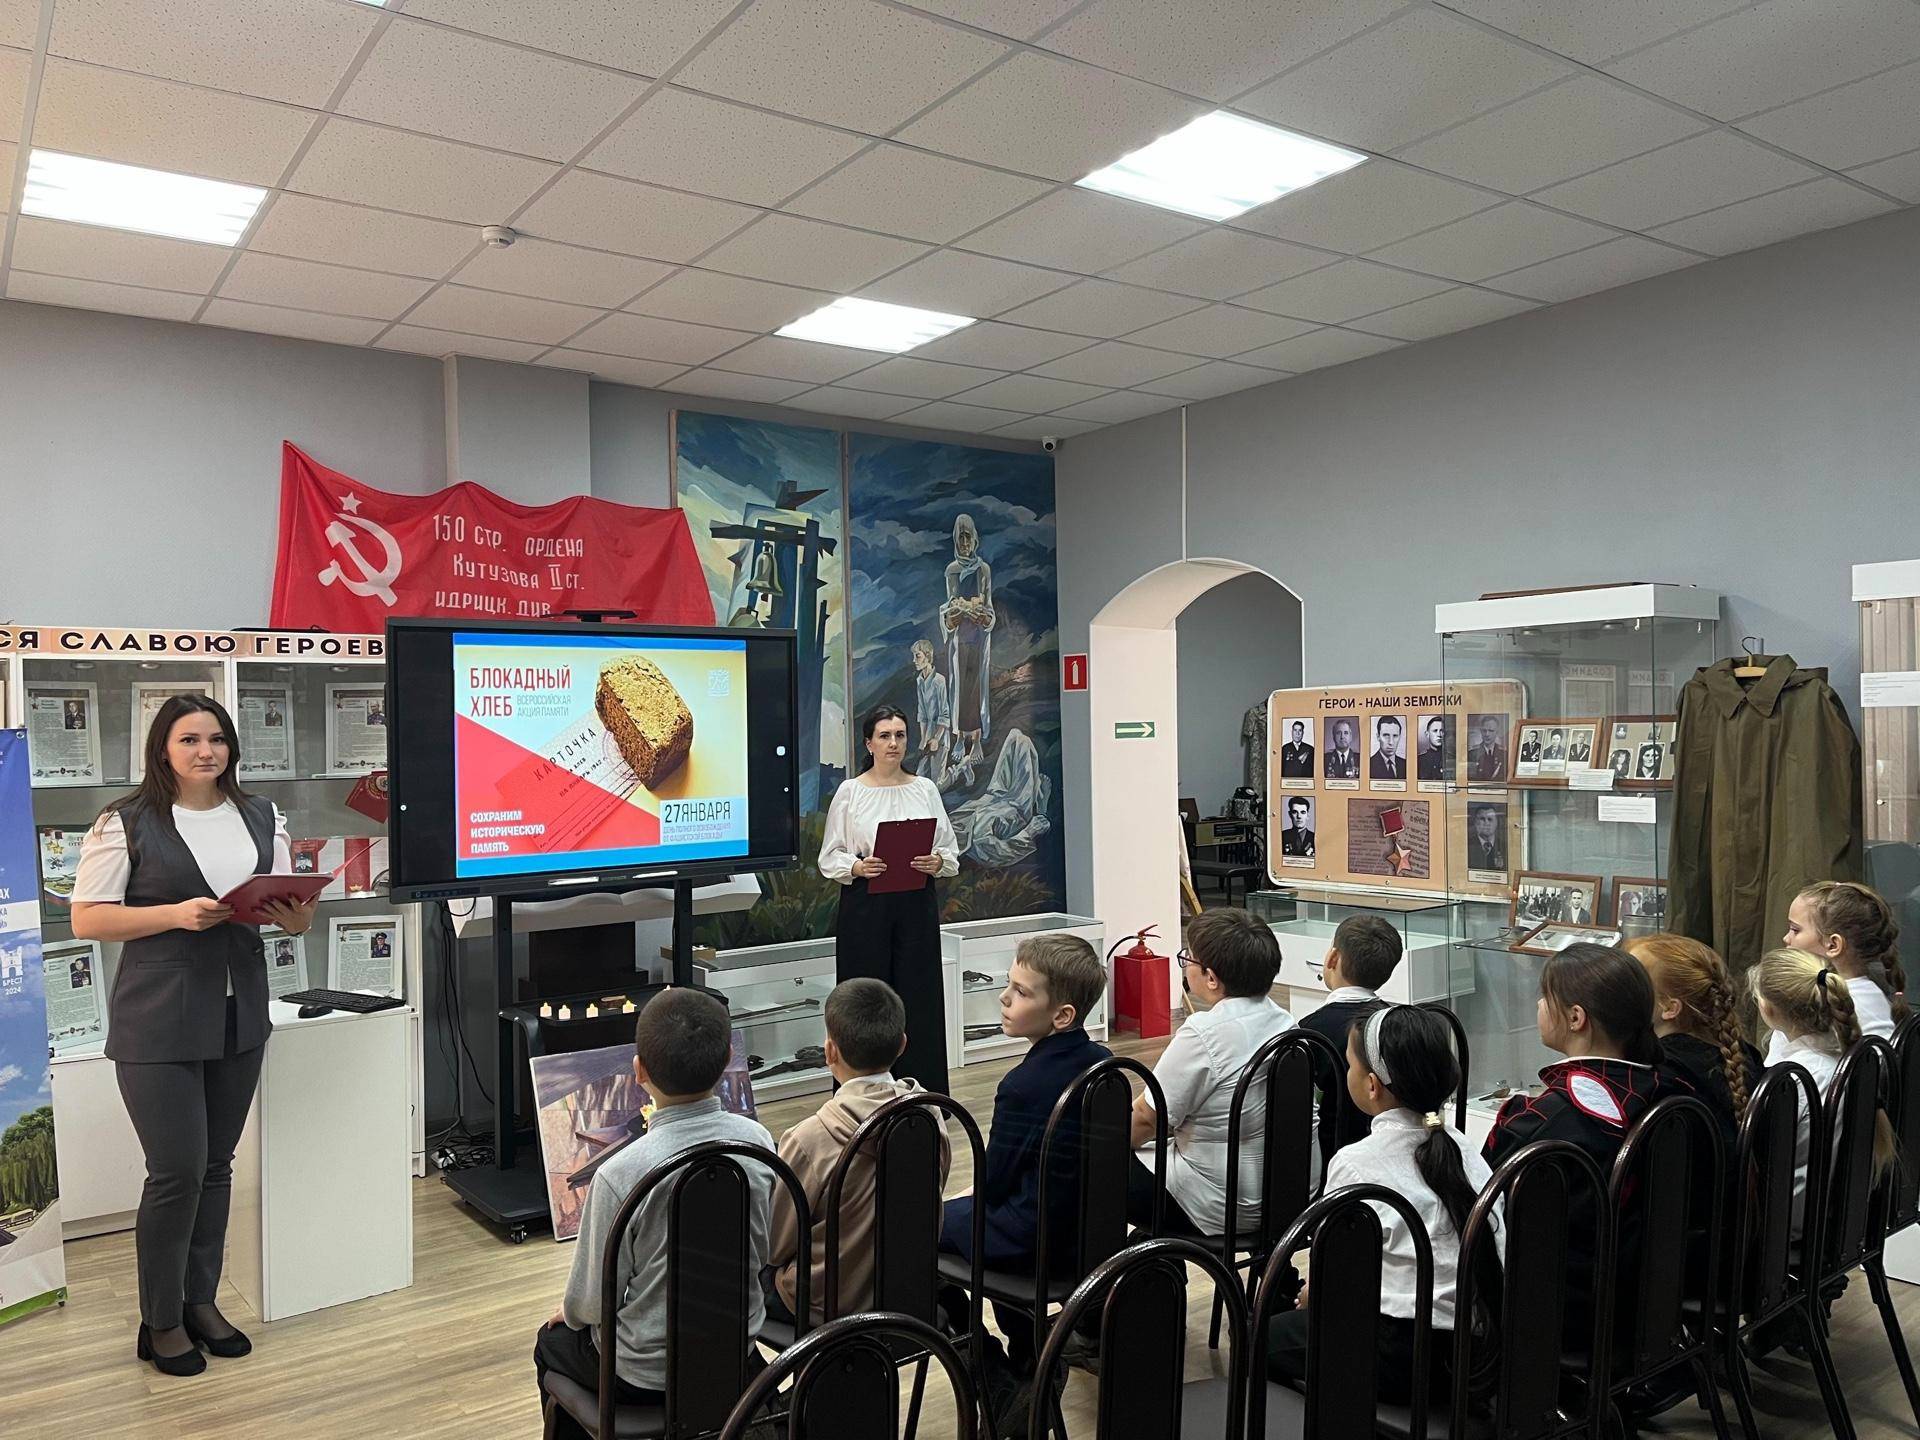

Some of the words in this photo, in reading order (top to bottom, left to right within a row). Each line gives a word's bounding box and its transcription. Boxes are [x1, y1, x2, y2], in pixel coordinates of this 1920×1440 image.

[433, 514, 465, 542] 150
[525, 537, 583, 557] ОРДЕНА
[60, 631, 236, 652] СЛАВОЮ
[254, 636, 384, 656] ГЕРОЕВ
[470, 664, 571, 691] БЛОКАДНЫЙ
[471, 696, 512, 717] ХЛЕБ
[516, 694, 571, 706] ВСЕРОССИЙСКАЯ
[1319, 698, 1356, 709] ГЕРОИ
[1366, 696, 1400, 708] НАШИ
[1404, 695, 1462, 707] ЗЕМЛЯКИ
[517, 707, 541, 718] АКЦИЯ
[542, 706, 569, 717] ПАМЯТИ
[533, 728, 596, 781] КАРТОЧКА
[470, 810, 522, 823] СОХРАНИМ
[471, 824, 545, 838] ИСТОРИЧЕСКУЮ
[471, 842, 509, 853] ПАМЯТЬ
